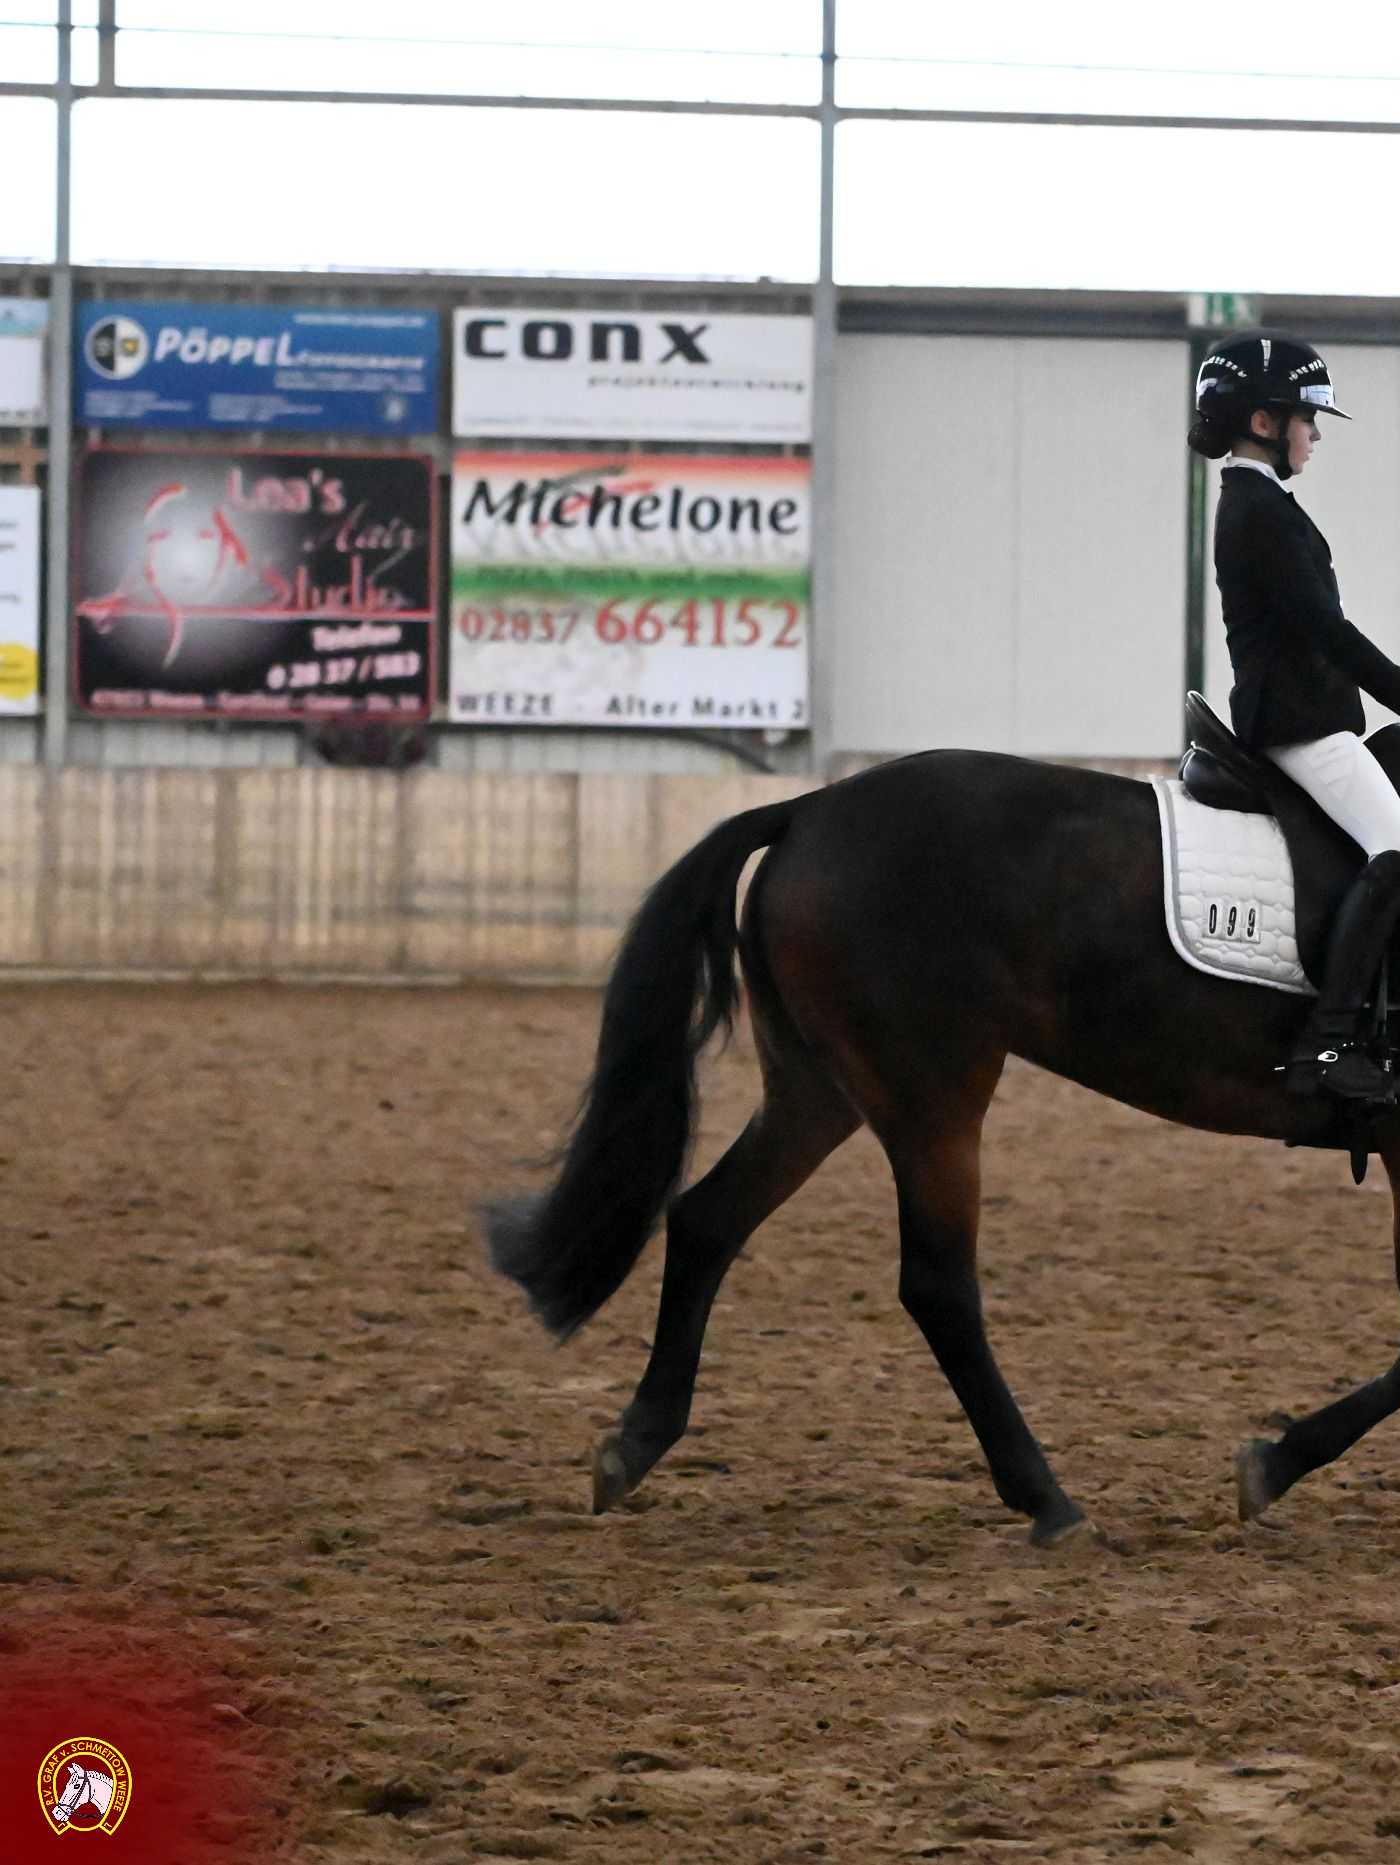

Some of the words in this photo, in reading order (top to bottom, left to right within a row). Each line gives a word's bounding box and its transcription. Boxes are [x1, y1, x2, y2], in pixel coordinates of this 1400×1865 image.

[154, 326, 293, 368] PÖPPEL
[464, 319, 712, 365] conx
[463, 478, 799, 534] Michelone
[457, 608, 580, 643] 02837
[595, 596, 803, 648] 664152
[456, 694, 555, 717] WEEZE
[604, 695, 678, 718] Alter
[691, 696, 777, 720] Markt
[1208, 903, 1257, 938] 099
